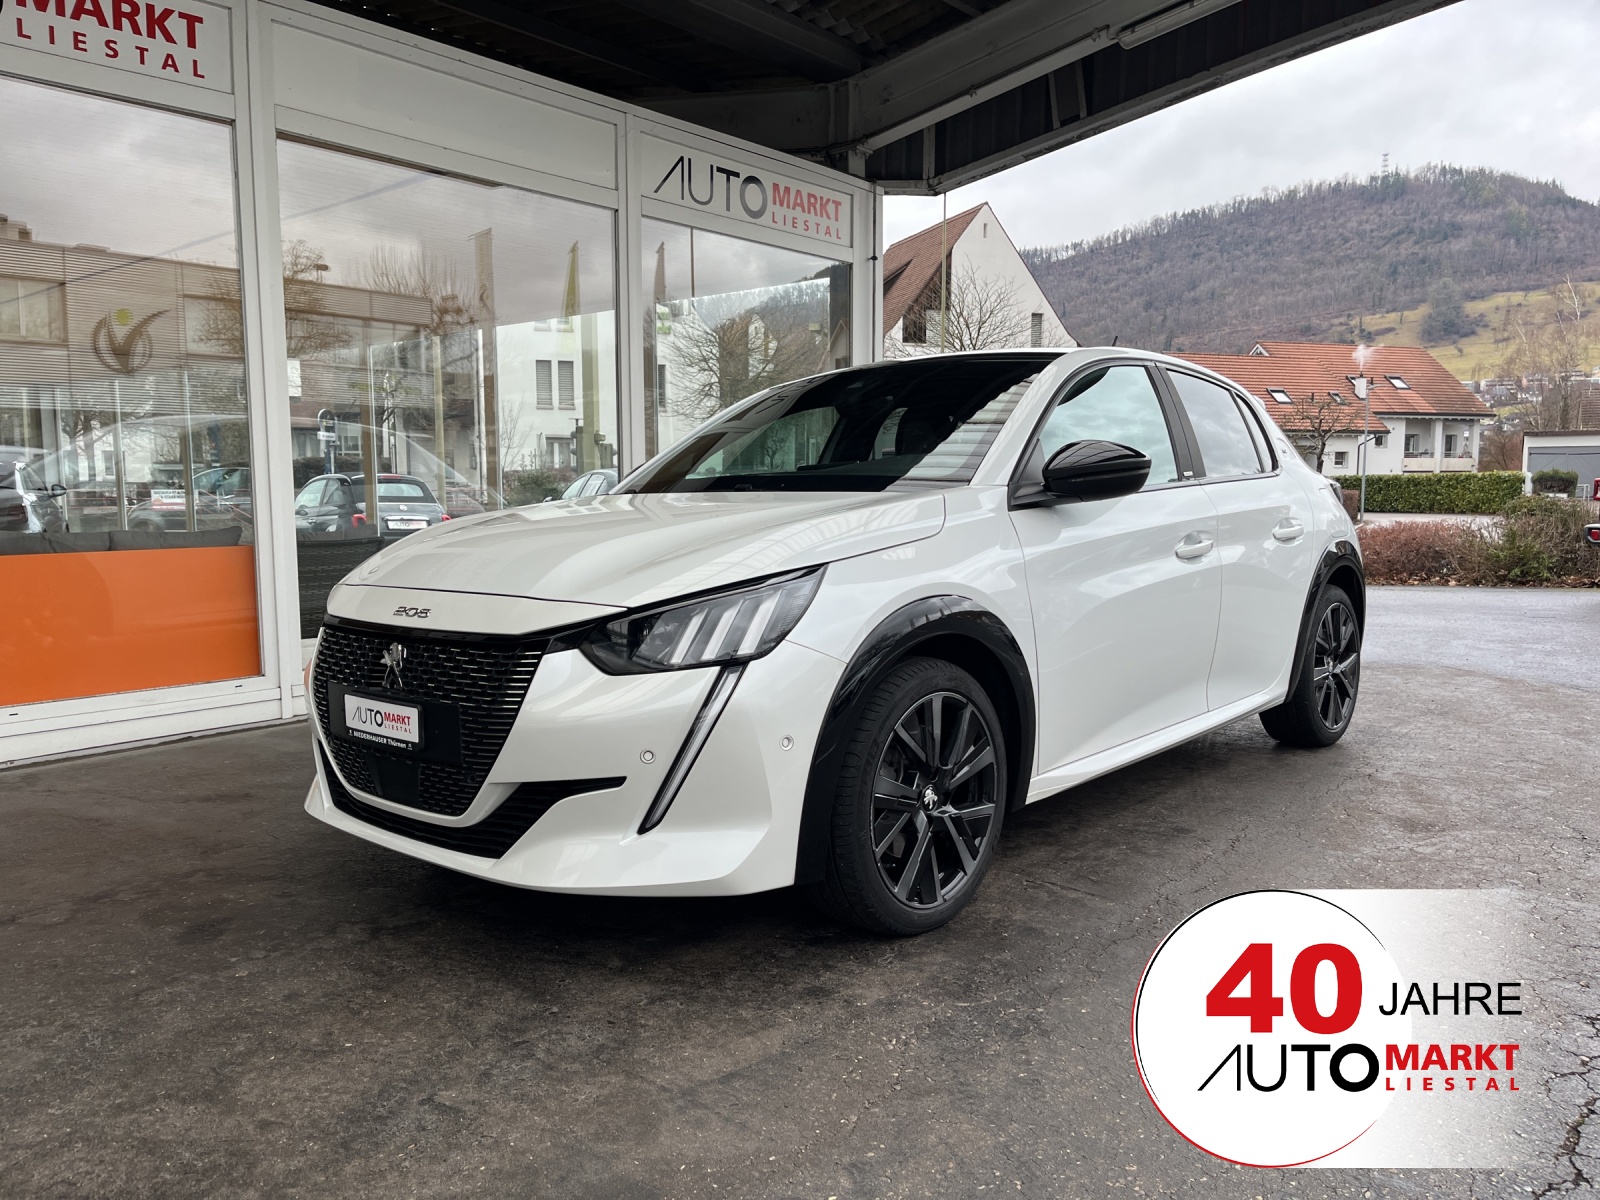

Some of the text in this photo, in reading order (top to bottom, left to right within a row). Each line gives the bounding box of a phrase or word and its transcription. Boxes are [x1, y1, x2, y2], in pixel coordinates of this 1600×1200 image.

[16, 17, 206, 79] LIESTAL
[653, 155, 842, 222] AUTO MARKT
[771, 211, 842, 240] LIESTAL
[352, 706, 411, 727] AUTO MARKT
[384, 724, 412, 734] LIESTAL
[353, 730, 387, 744] NIEDERHAUSER
